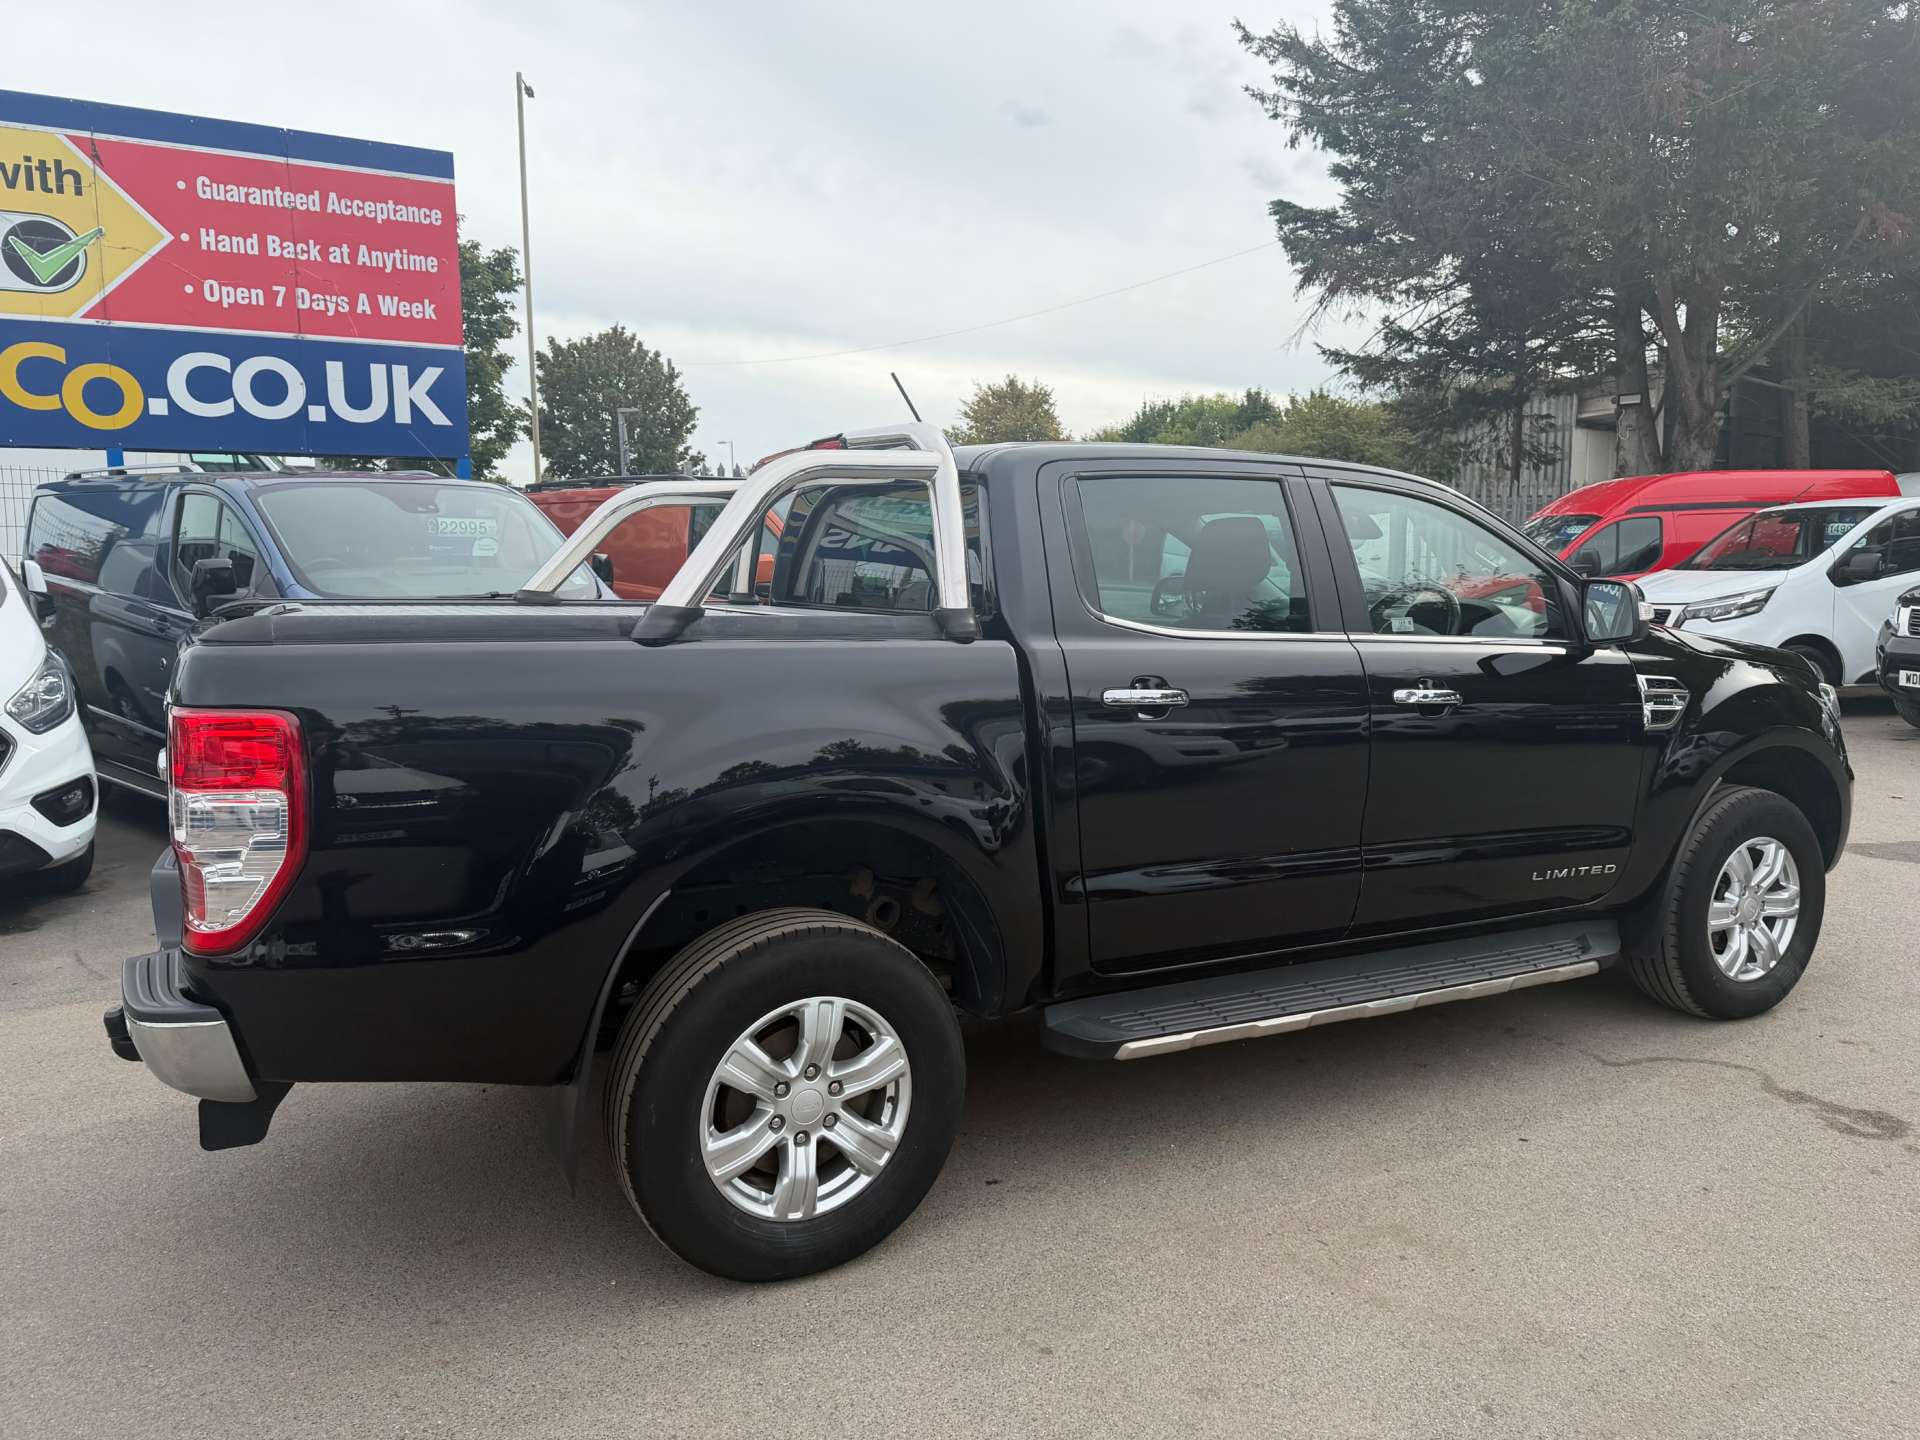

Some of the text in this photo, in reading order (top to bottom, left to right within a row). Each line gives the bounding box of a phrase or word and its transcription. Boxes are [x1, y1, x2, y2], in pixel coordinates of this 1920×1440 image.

[196, 175, 442, 226] Guaranteed Acceptance
[200, 227, 438, 273] Hand Back at Anytime
[203, 279, 437, 320] Open 7 Days A Week
[1531, 864, 1617, 881] LIMITED
